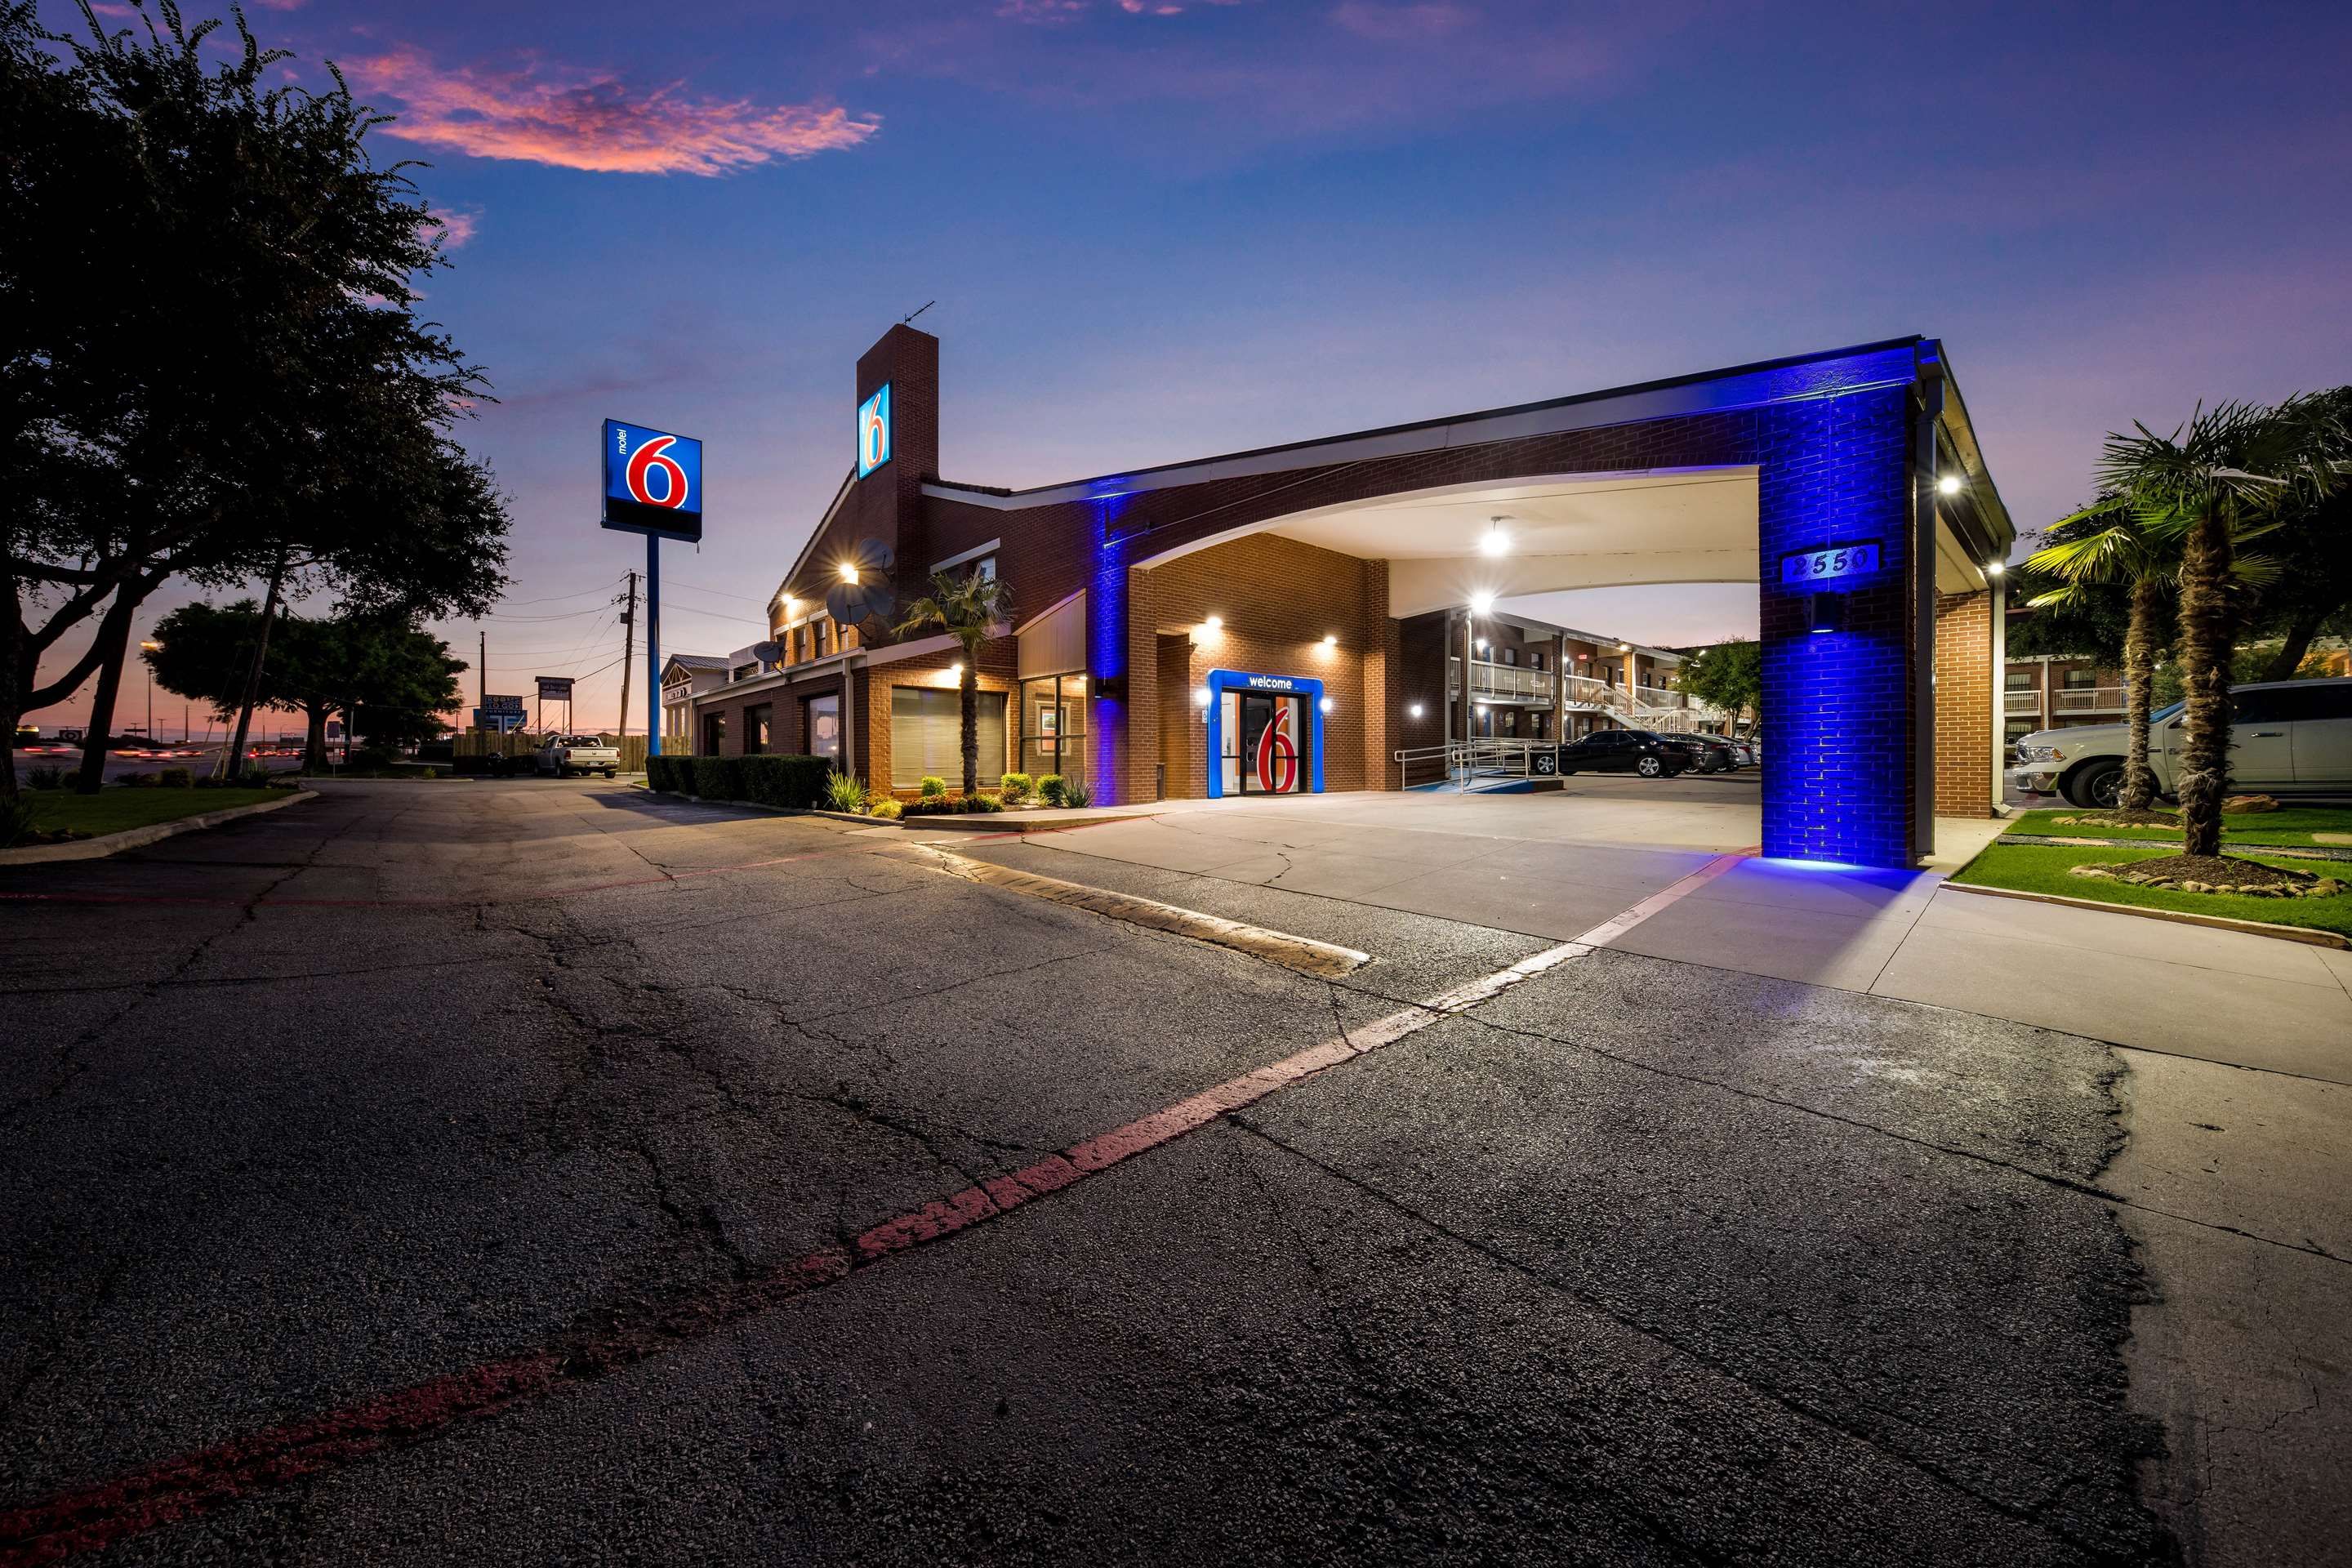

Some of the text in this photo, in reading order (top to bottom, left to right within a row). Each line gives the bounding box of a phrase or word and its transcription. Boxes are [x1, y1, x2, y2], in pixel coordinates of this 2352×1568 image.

[617, 429, 688, 509] motel 6
[865, 393, 885, 470] 6
[1792, 549, 1869, 576] 2550
[1249, 676, 1293, 689] welcome
[1256, 706, 1297, 792] 6
